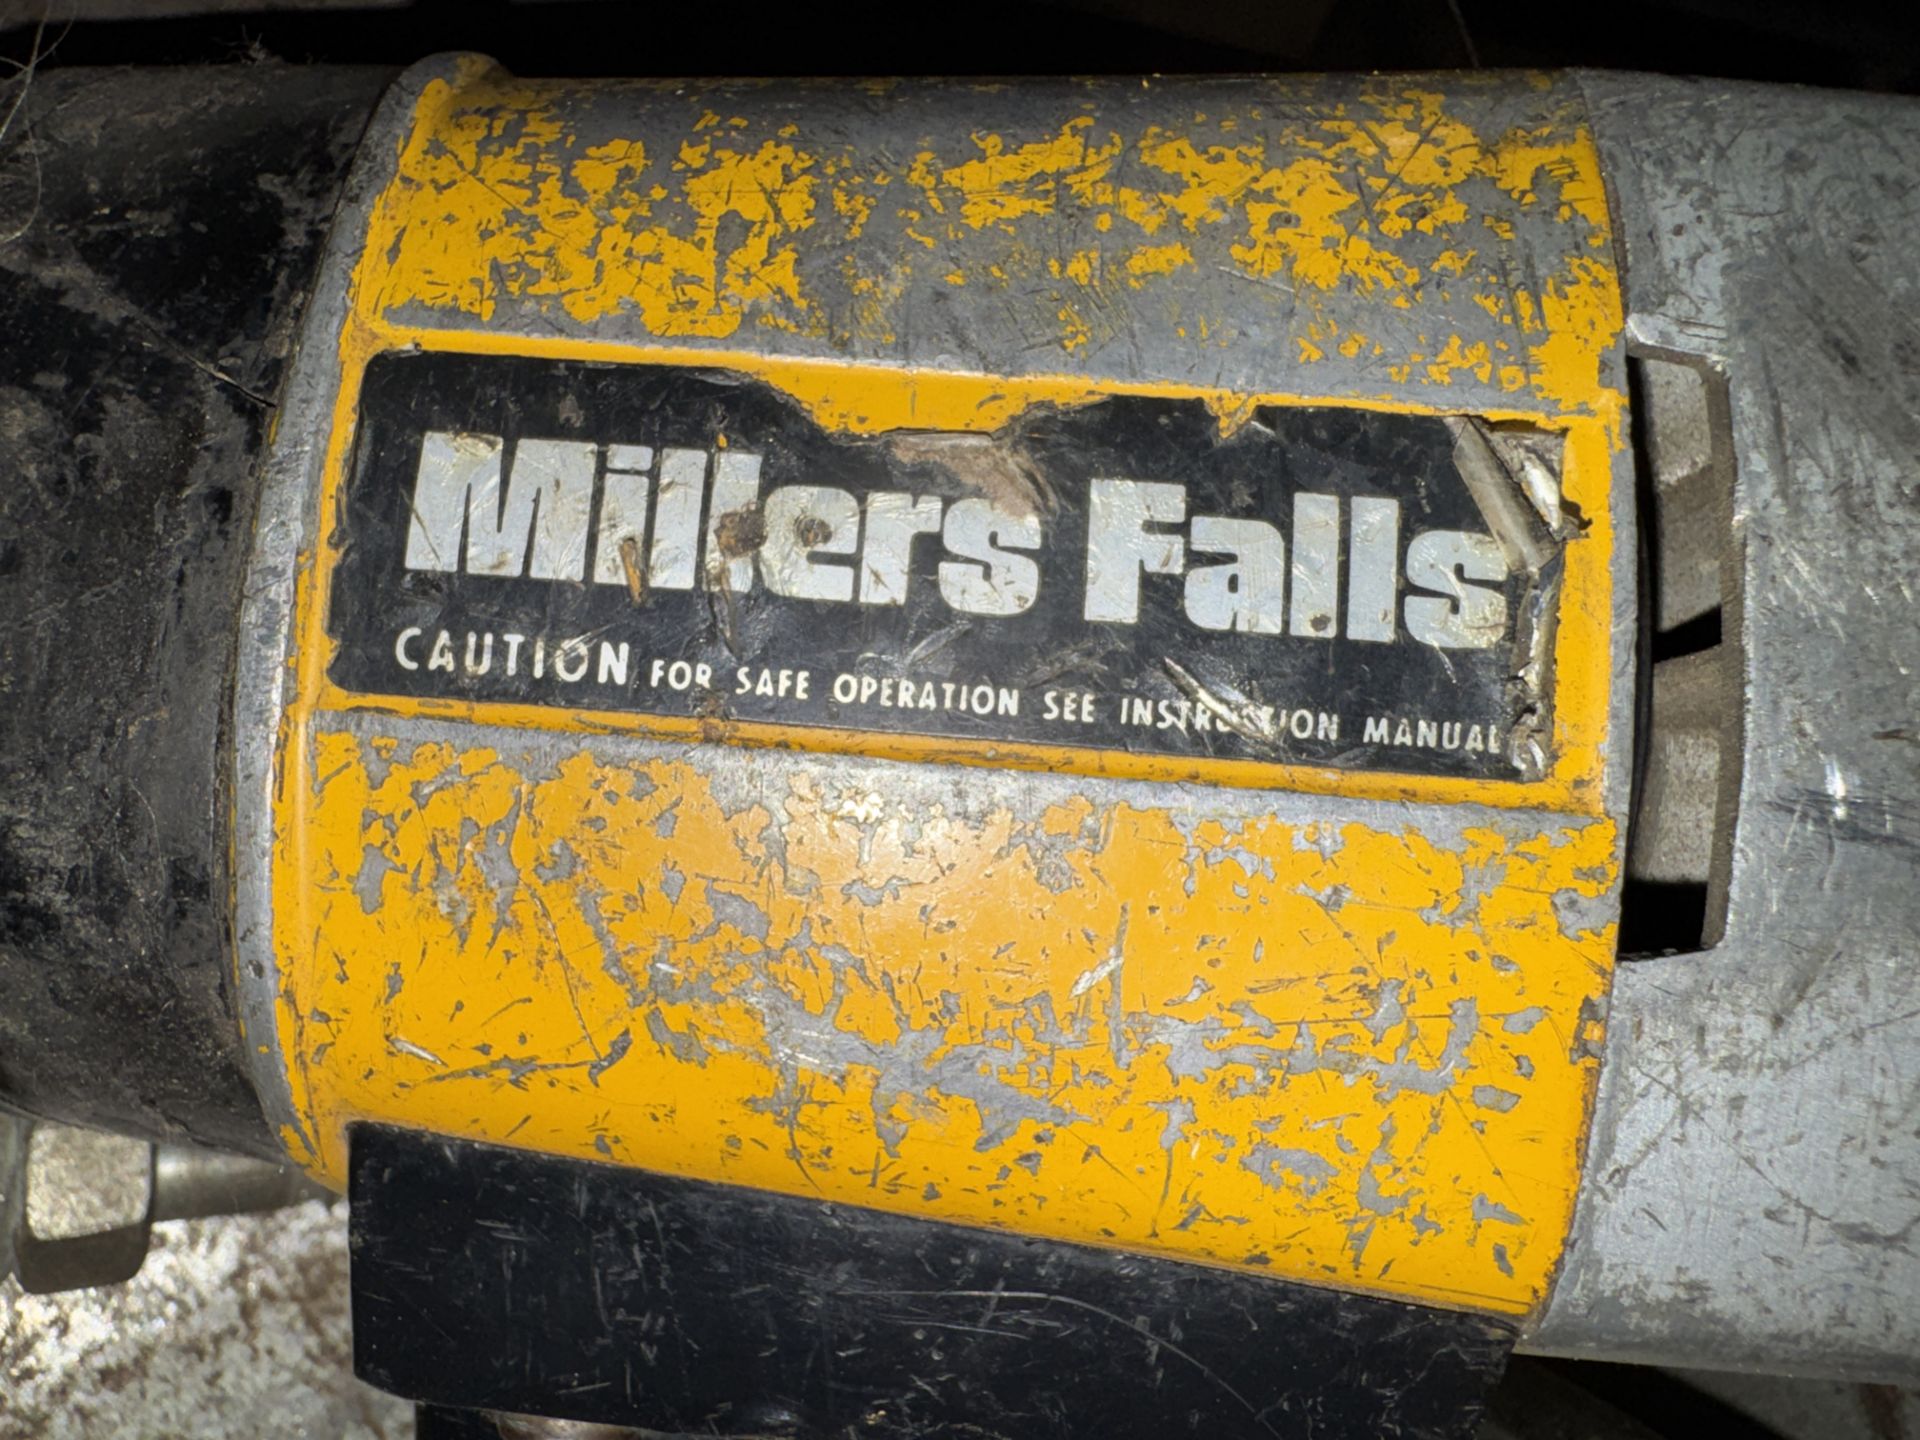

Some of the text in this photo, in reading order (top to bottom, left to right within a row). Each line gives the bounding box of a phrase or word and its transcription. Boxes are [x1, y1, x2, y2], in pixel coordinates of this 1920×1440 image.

[405, 431, 1508, 650] Millers Falls
[395, 626, 1501, 755] CAUTION FOR SAFE OPERATION SEE INSTRTION MANUAL
